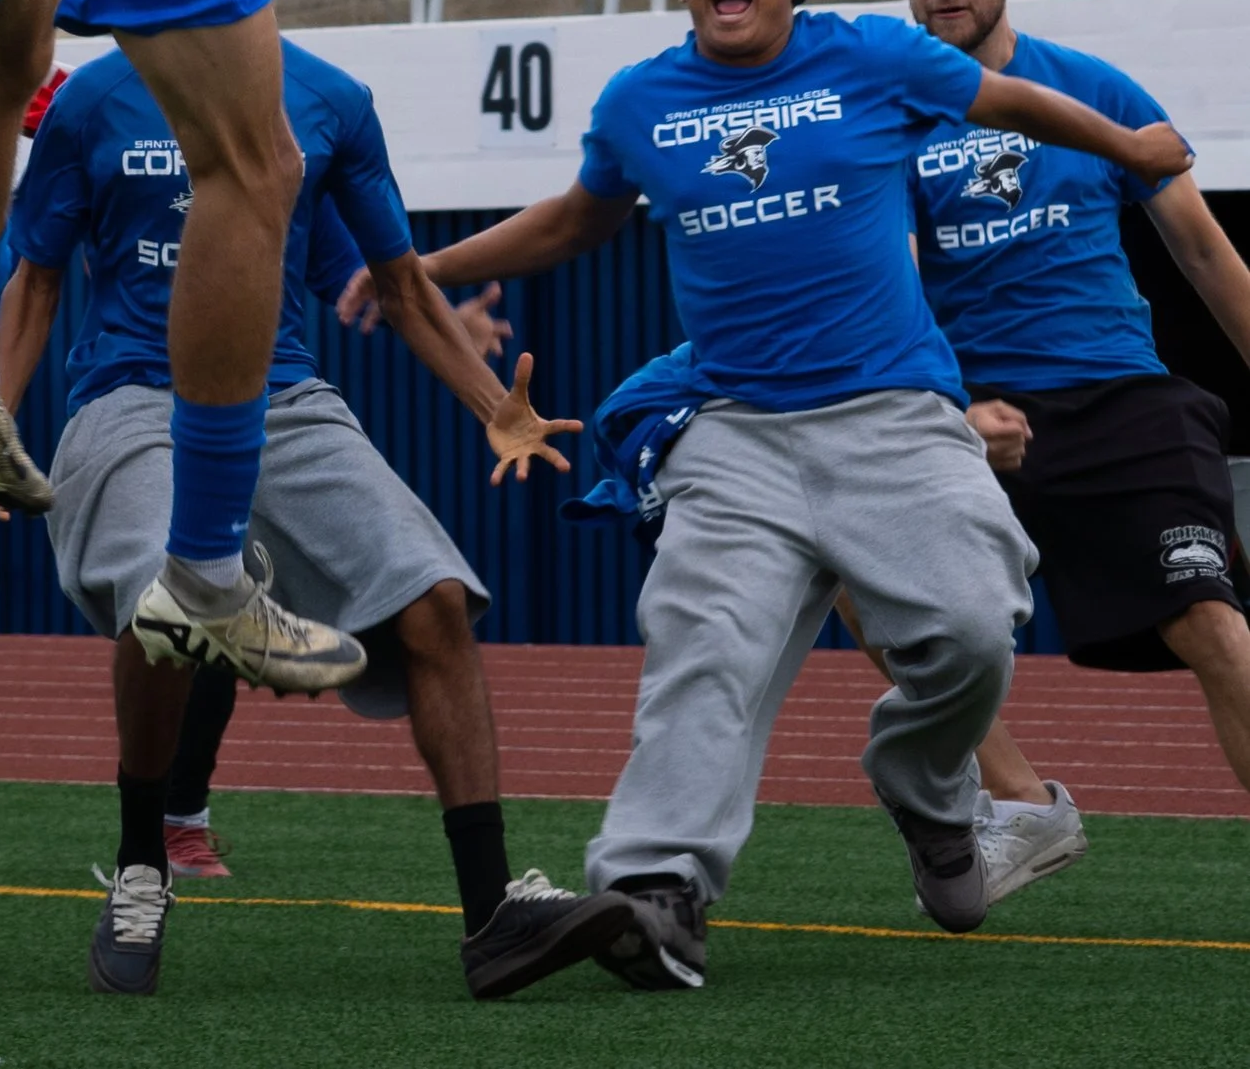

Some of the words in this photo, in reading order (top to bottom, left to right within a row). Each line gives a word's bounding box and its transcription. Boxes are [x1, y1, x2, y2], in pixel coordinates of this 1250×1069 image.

[481, 41, 552, 131] 40
[665, 107, 708, 122] SANTA
[711, 99, 765, 114] MONICA
[768, 88, 830, 107] COLLEGE
[653, 94, 842, 148] CORSAIRS
[678, 184, 841, 236] SOCCER
[936, 204, 1069, 249] SOCCER
